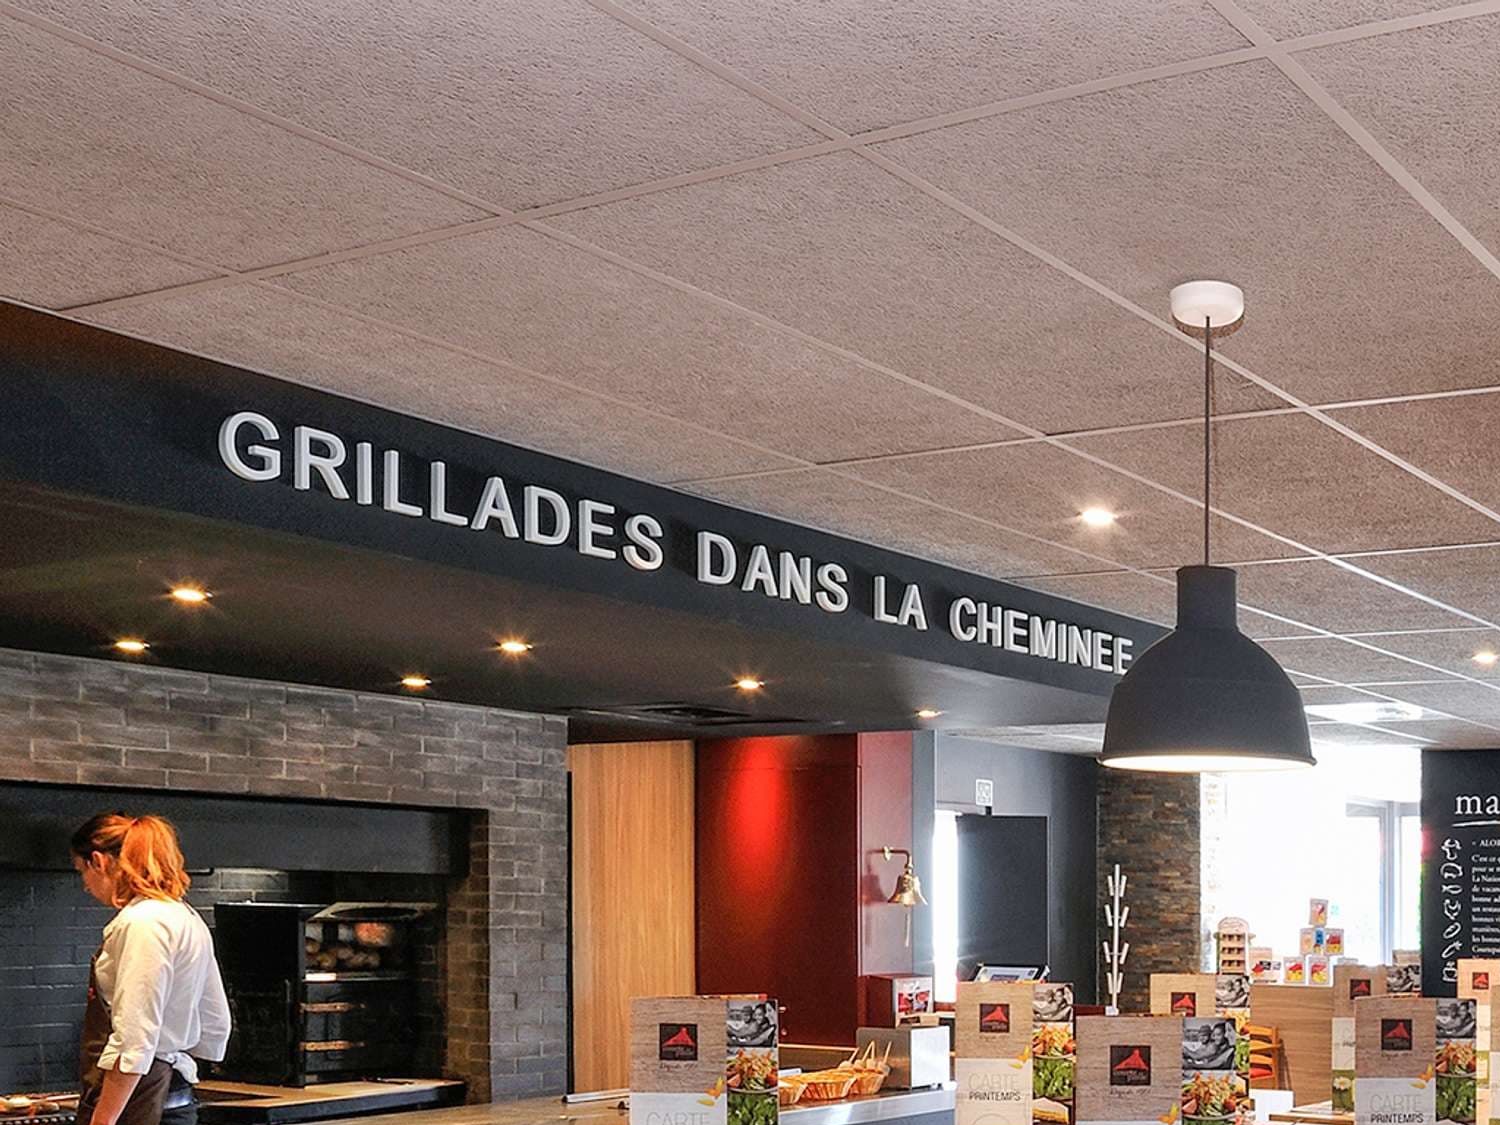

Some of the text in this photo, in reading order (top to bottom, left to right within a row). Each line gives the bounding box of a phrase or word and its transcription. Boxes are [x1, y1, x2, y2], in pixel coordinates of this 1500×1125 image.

[218, 411, 1134, 675] GRILLADES DANS LA CHEMINEE
[969, 1090, 1021, 1102] PRINTEMPS
[1370, 1113, 1425, 1125] PRINTEMPS
